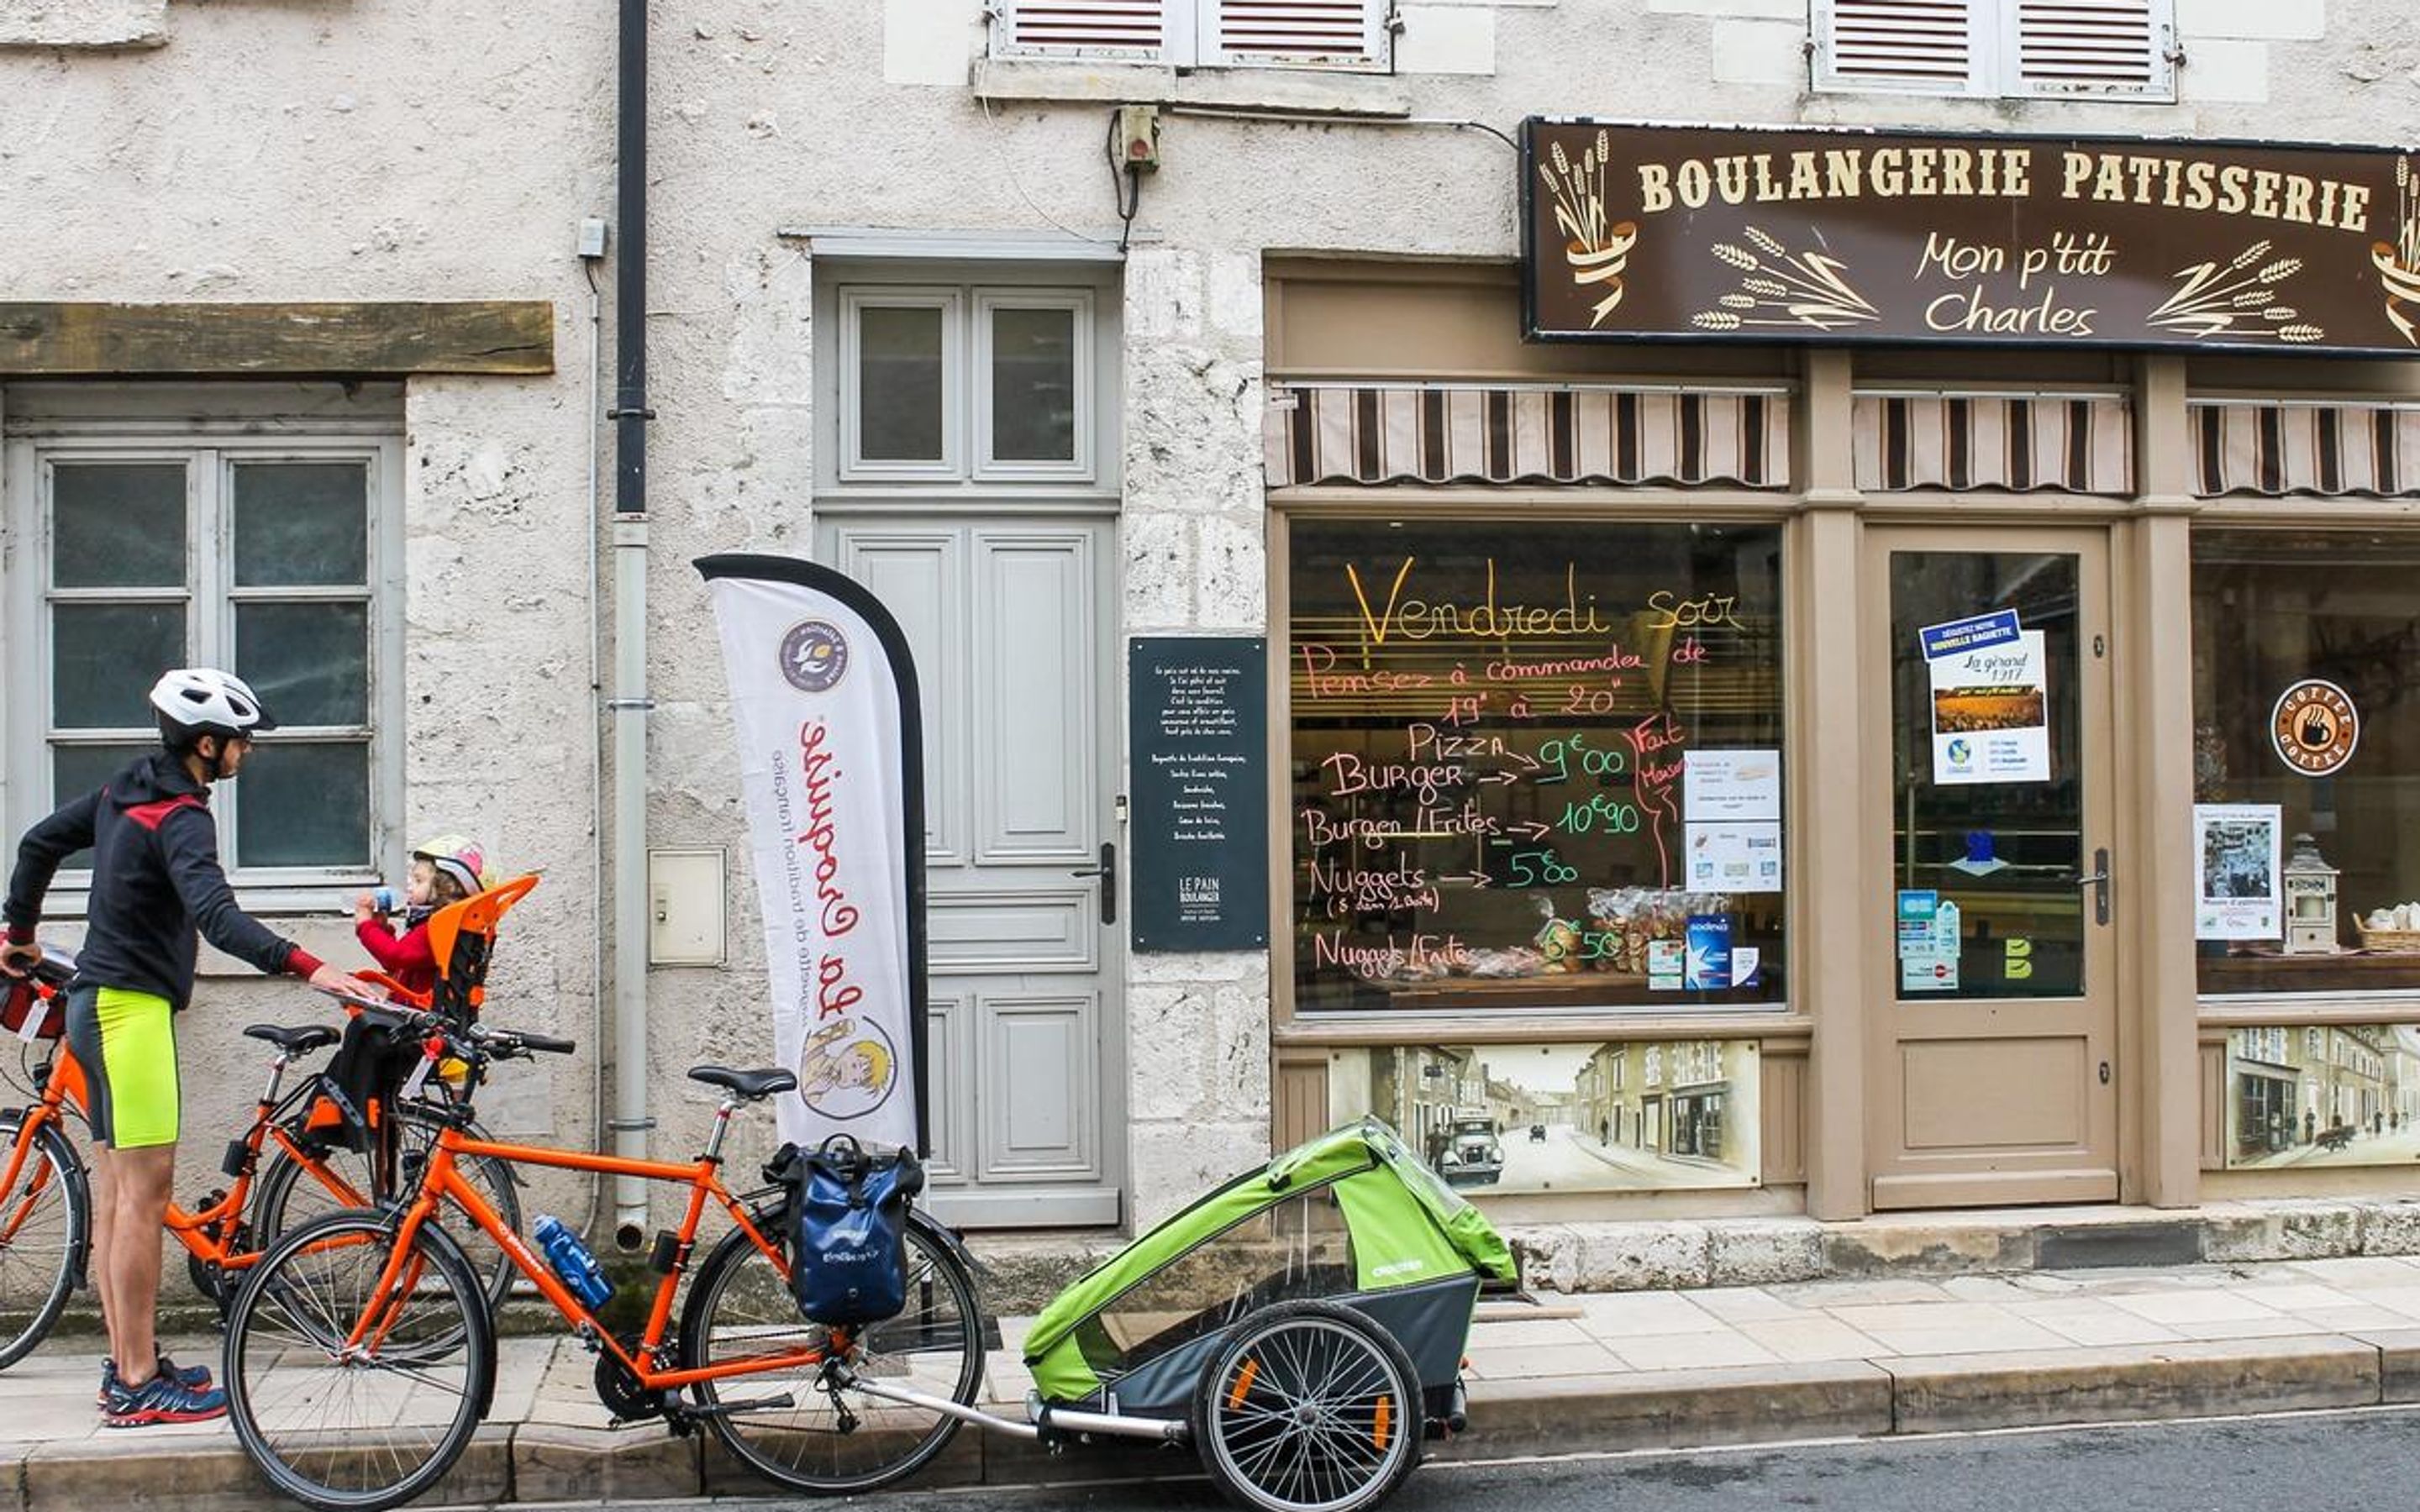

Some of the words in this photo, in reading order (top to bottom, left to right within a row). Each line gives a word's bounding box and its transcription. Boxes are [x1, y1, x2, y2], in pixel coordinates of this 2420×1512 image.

[1638, 149, 2031, 213] BOULANGERIE
[2061, 155, 2371, 234] PATISSERIE
[1914, 230, 2005, 281] Mon
[2020, 231, 2118, 290] p'tit
[1924, 284, 2098, 338] Charles
[1346, 556, 1610, 644] Vendredi
[1451, 657, 1472, 686] à
[1673, 637, 1710, 664] de
[1510, 695, 1539, 719] à
[2285, 685, 2351, 725] COFFEE
[1180, 877, 1192, 891] LE
[1194, 877, 1219, 891] PAIN
[1309, 852, 1426, 902] Nuggets
